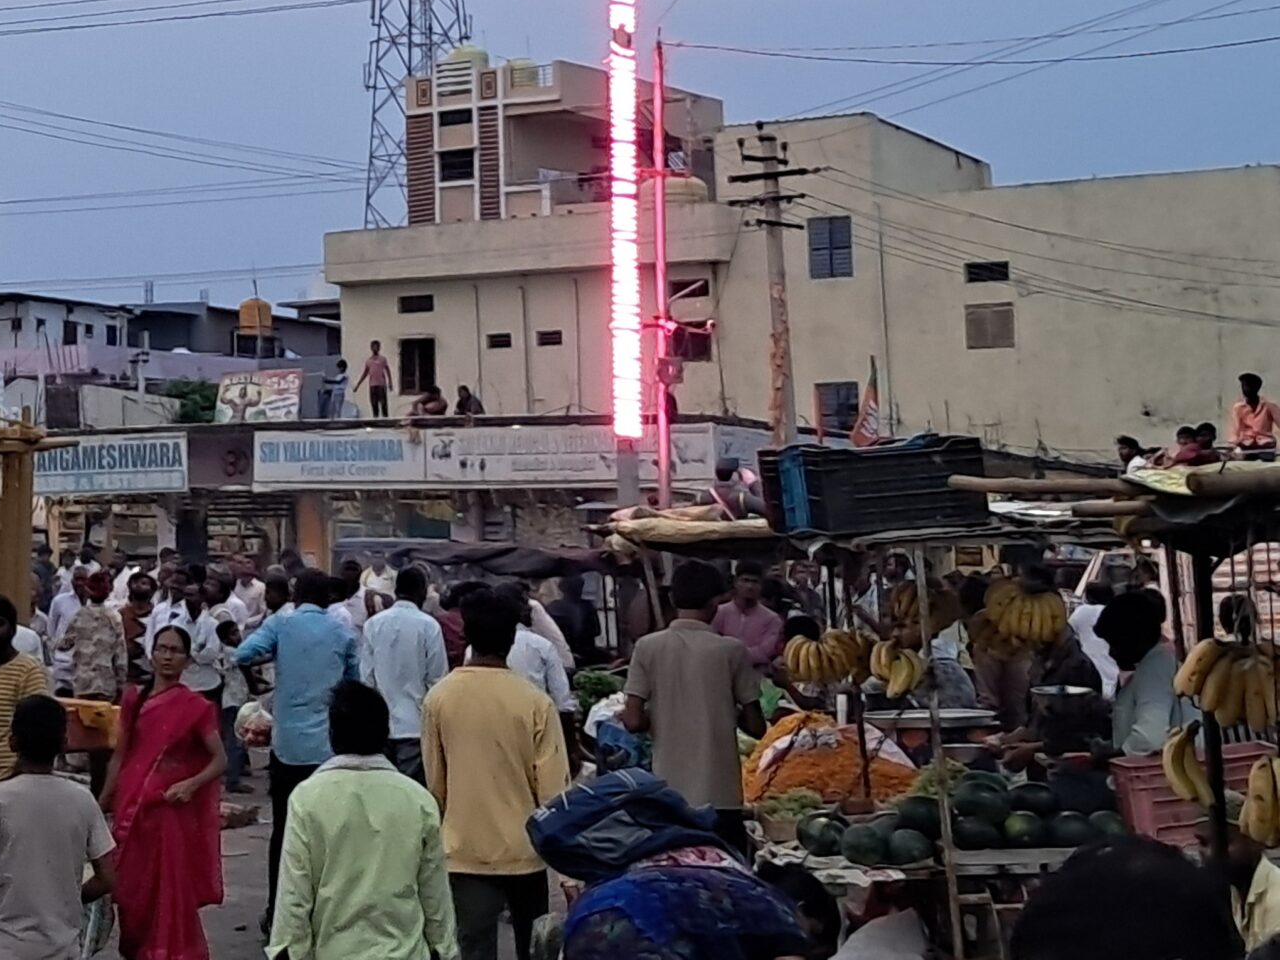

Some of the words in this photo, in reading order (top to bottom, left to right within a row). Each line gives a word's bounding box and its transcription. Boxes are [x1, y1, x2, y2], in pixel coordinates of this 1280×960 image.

[36, 441, 183, 472] ANGAMESHWARA
[260, 441, 279, 462] SRI
[300, 465, 324, 476] First
[348, 464, 387, 476] Centre
